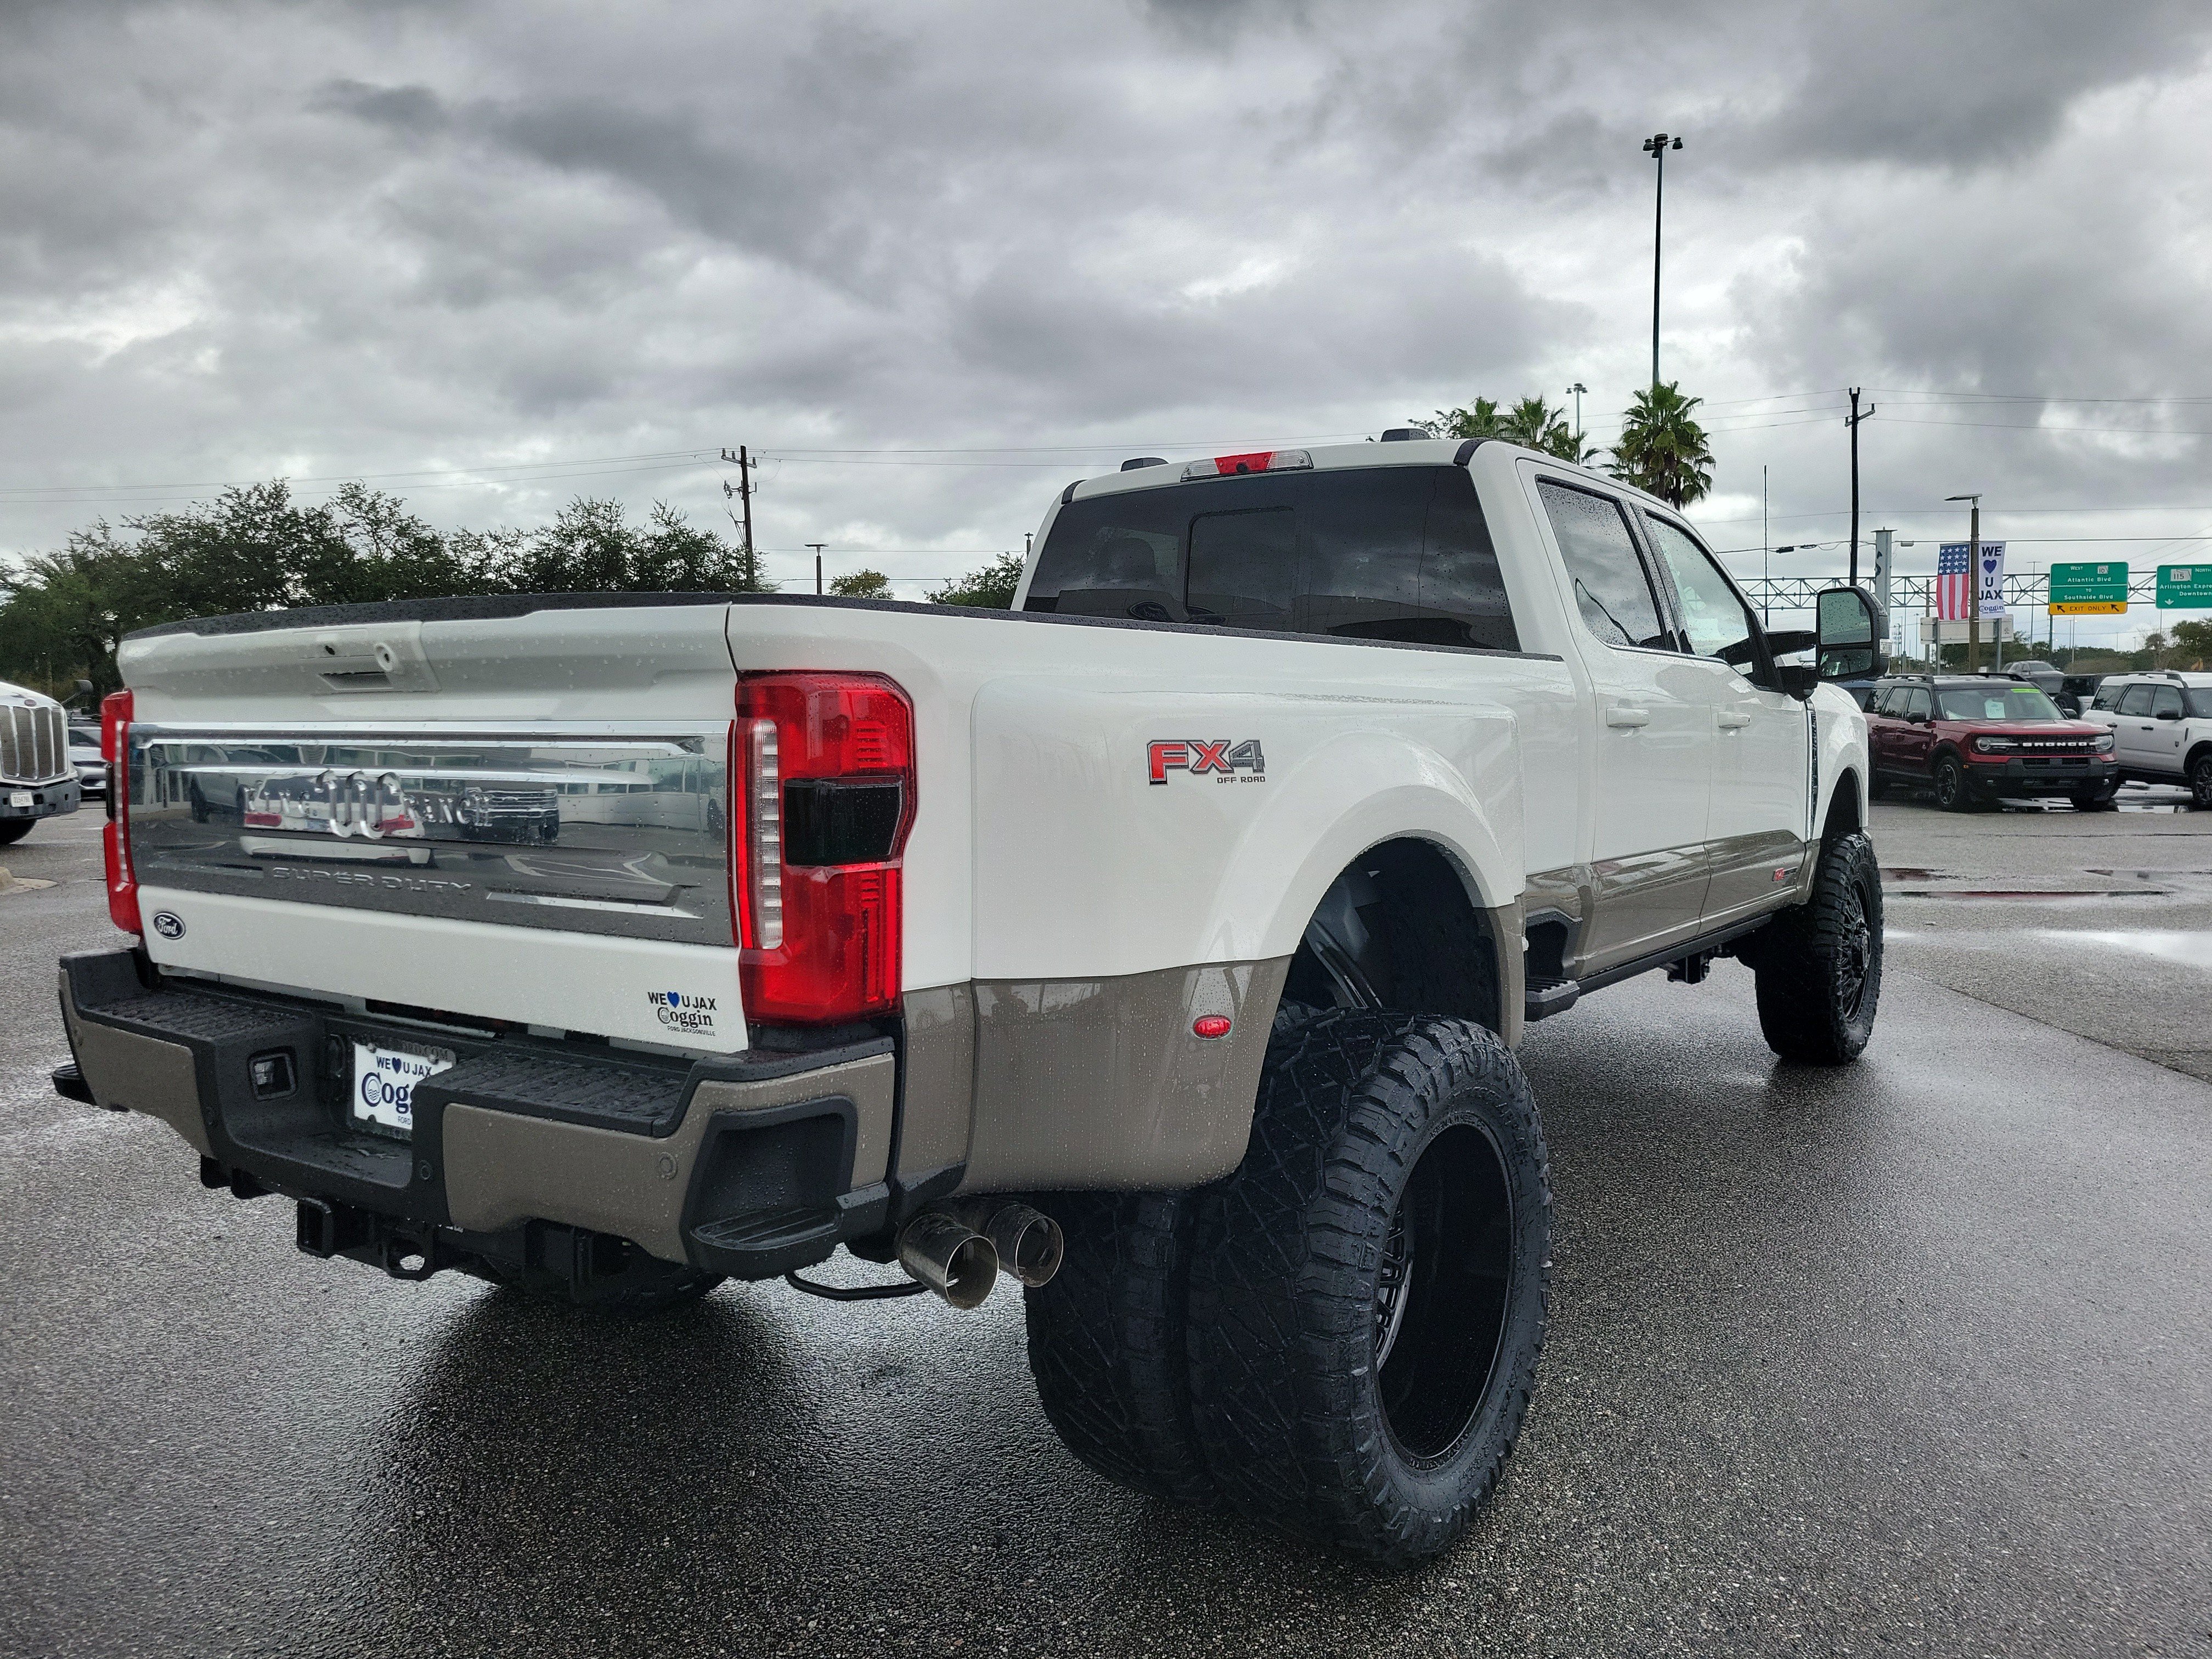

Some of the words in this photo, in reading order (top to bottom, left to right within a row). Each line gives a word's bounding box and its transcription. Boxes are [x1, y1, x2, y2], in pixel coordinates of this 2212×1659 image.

[1982, 546, 2002, 557] WE
[1985, 577, 1994, 587] U
[1978, 589, 2003, 600] JAX
[1146, 740, 1266, 786] FX4
[273, 867, 375, 887] SUPER
[382, 876, 472, 895] DUTY
[647, 991, 668, 1005] WE
[681, 995, 691, 1008] U
[692, 997, 718, 1011] JAX
[658, 1006, 714, 1029] Coggin
[376, 1056, 391, 1070] WE
[403, 1062, 410, 1074] U
[412, 1064, 432, 1077] JAX
[362, 1072, 412, 1114] Cog
[398, 1115, 411, 1125] FORD
